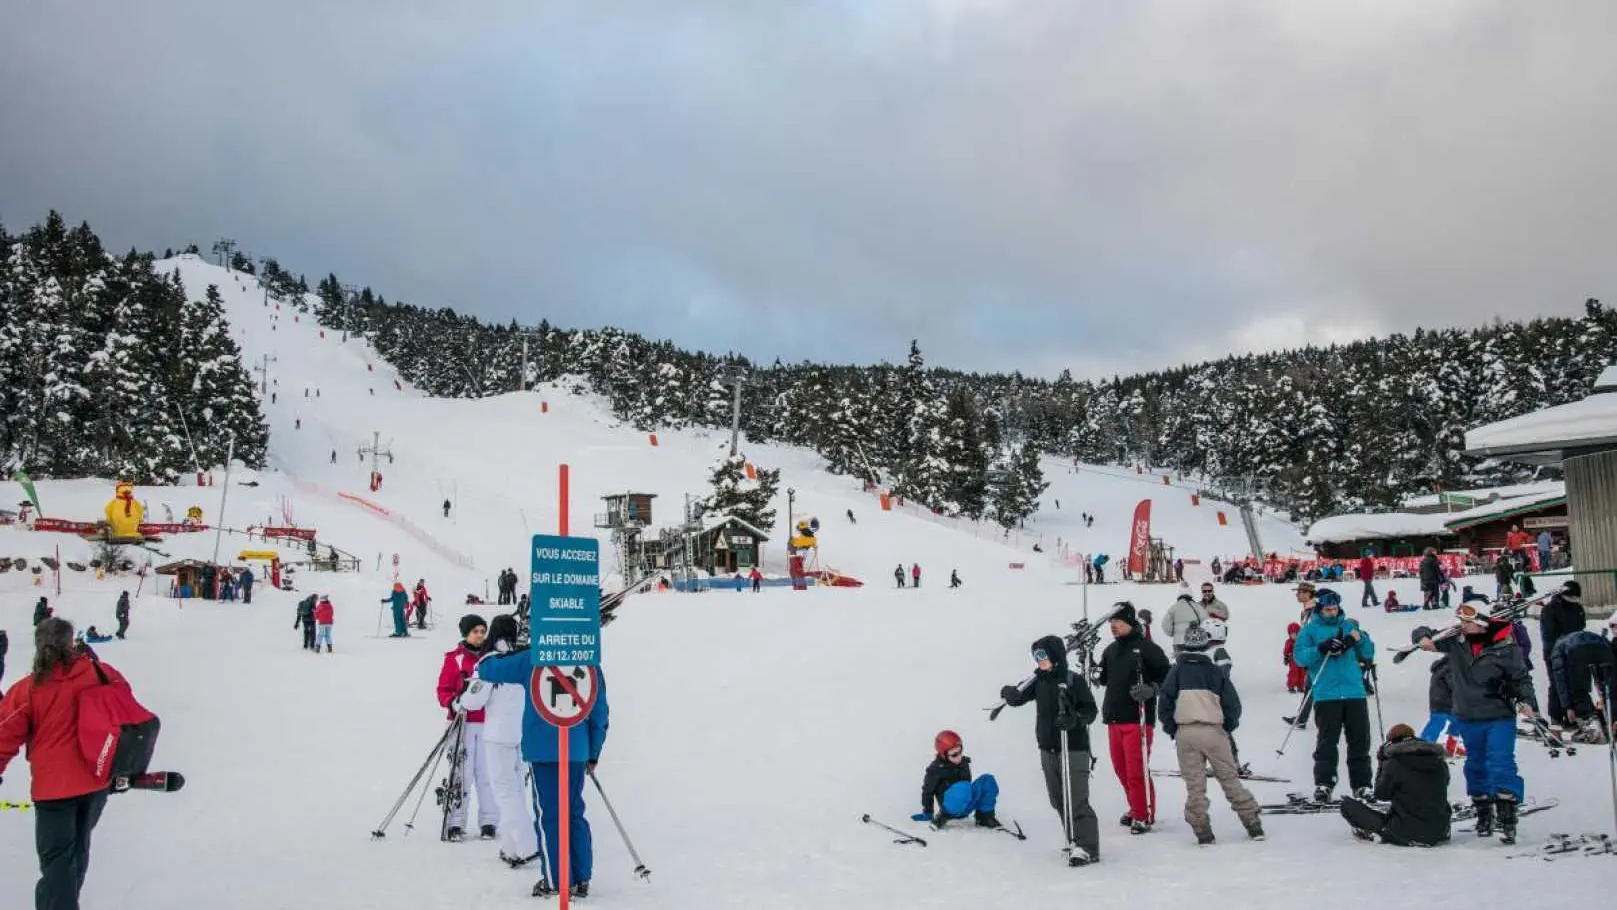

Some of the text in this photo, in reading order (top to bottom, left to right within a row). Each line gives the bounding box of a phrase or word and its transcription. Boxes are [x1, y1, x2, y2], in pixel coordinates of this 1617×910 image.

[536, 547, 560, 560] VOUS
[532, 572, 599, 586] SUR LE DOMAINE
[549, 597, 584, 609] SKIABLE
[539, 634, 595, 645] ARRETE DU
